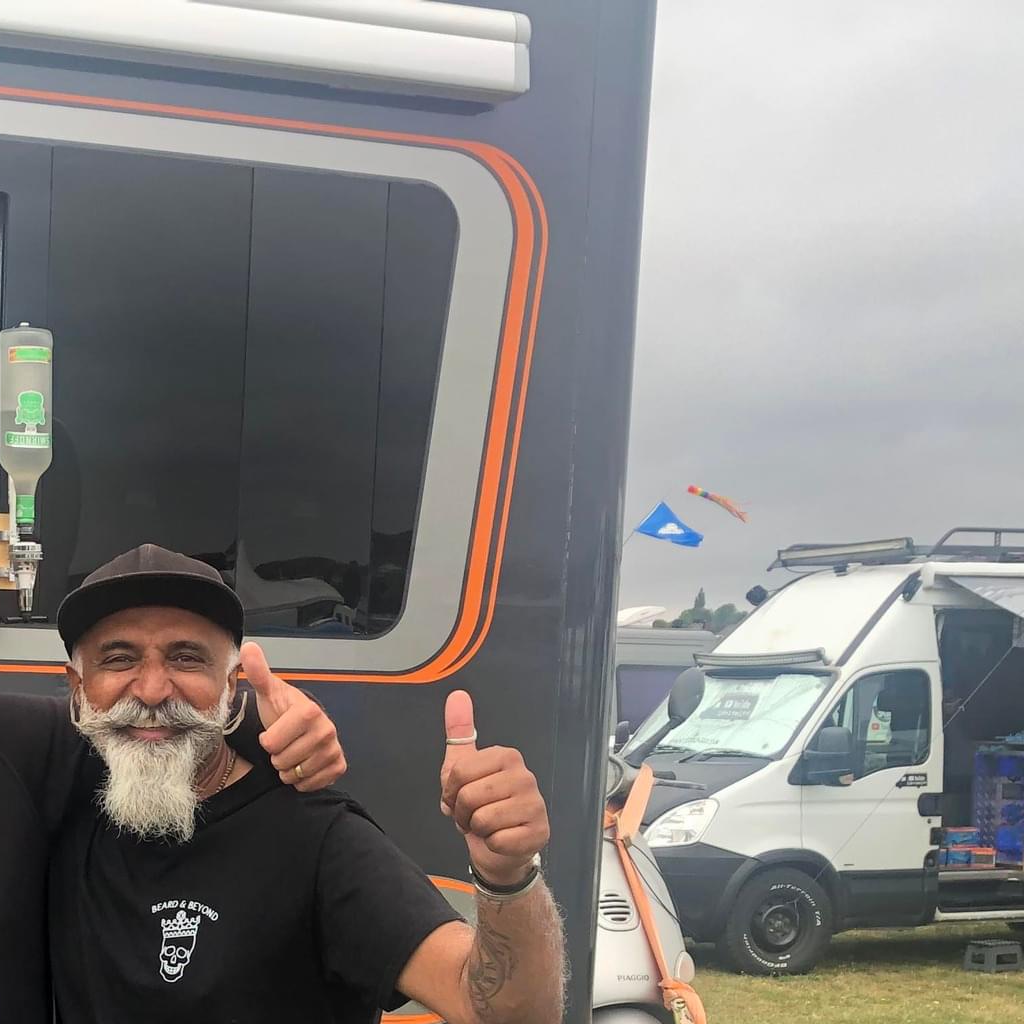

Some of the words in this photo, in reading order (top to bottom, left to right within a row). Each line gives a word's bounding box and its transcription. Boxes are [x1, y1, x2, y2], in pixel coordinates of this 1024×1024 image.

[151, 900, 179, 914] BEARD
[179, 900, 187, 909] &
[187, 900, 219, 921] BEYOND
[617, 974, 650, 982] PIAGGIO
